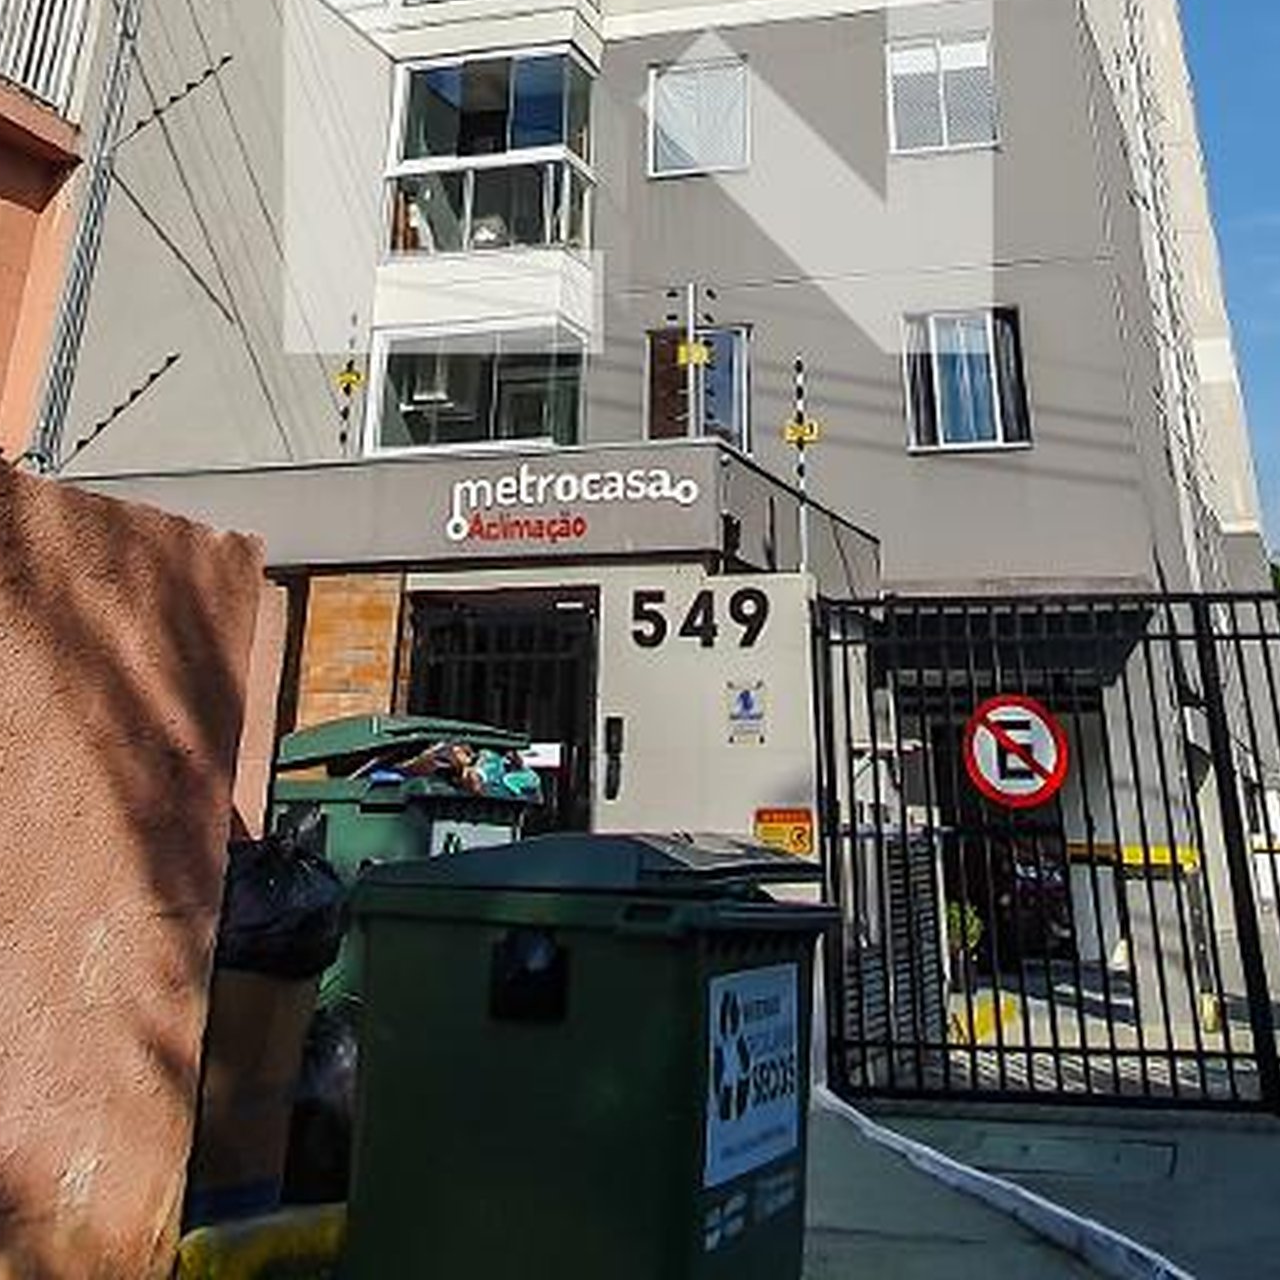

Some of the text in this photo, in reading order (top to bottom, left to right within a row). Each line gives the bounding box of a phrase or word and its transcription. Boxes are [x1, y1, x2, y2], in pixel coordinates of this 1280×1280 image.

[447, 464, 697, 540] metrocasa
[470, 513, 587, 543] Aclimação
[632, 588, 769, 648] 549
